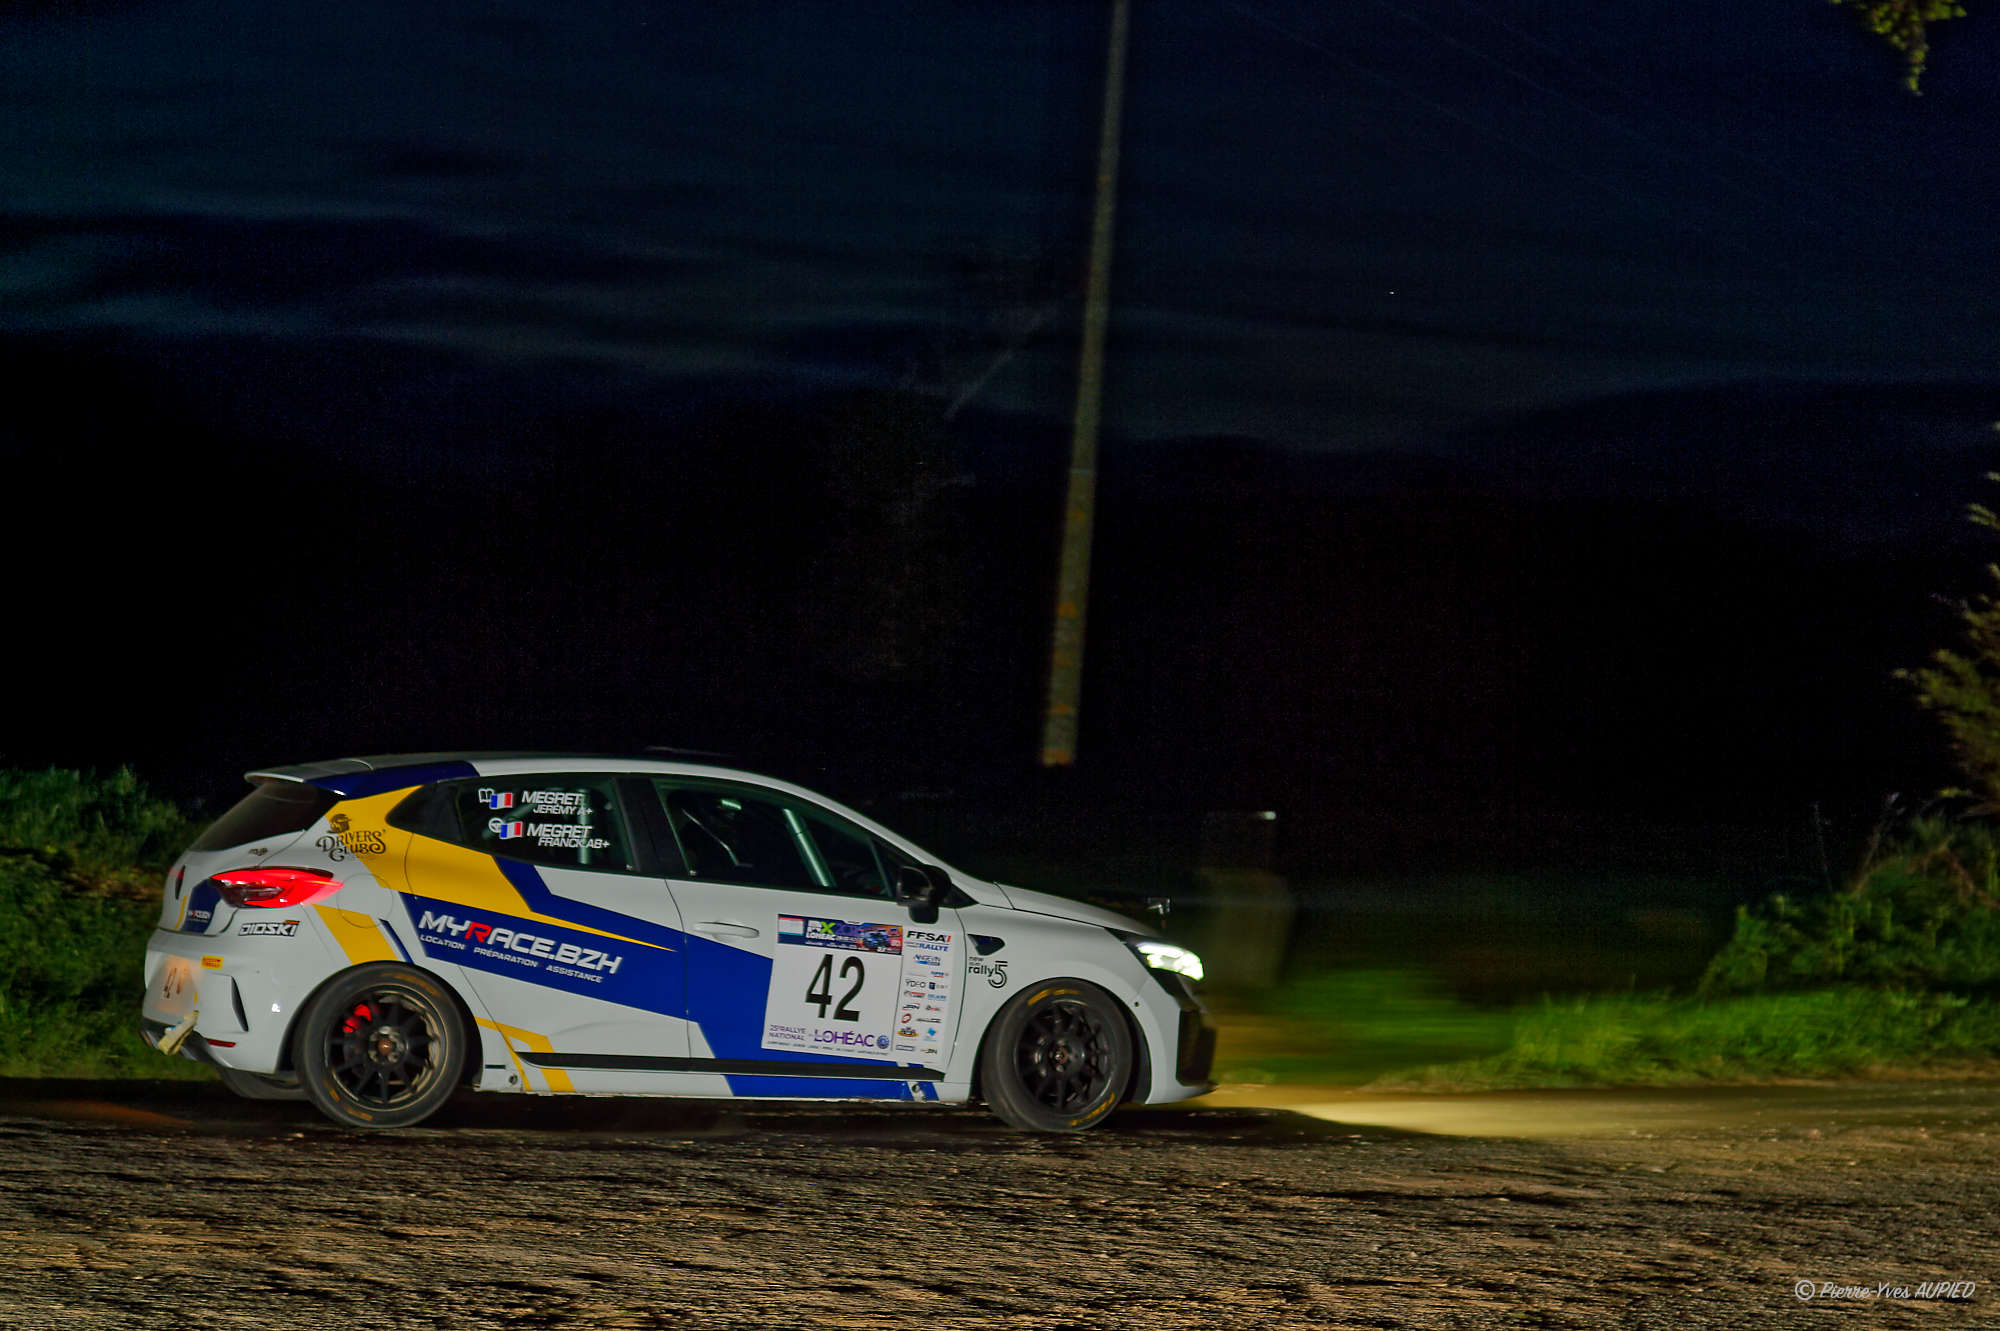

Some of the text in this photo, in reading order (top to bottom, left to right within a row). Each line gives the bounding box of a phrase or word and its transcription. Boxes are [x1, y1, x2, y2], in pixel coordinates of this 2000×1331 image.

[522, 790, 585, 805] MEGRET
[527, 822, 593, 839] MEGRET
[538, 838, 611, 849] FRANCK AB+
[418, 910, 623, 975] MYRACE.BZH
[906, 930, 946, 943] FFSA
[420, 934, 465, 951] LOCATION
[546, 964, 603, 984] ASSISTANCE
[804, 953, 865, 1022] 42
[813, 1029, 875, 1048] LOHÉAC
